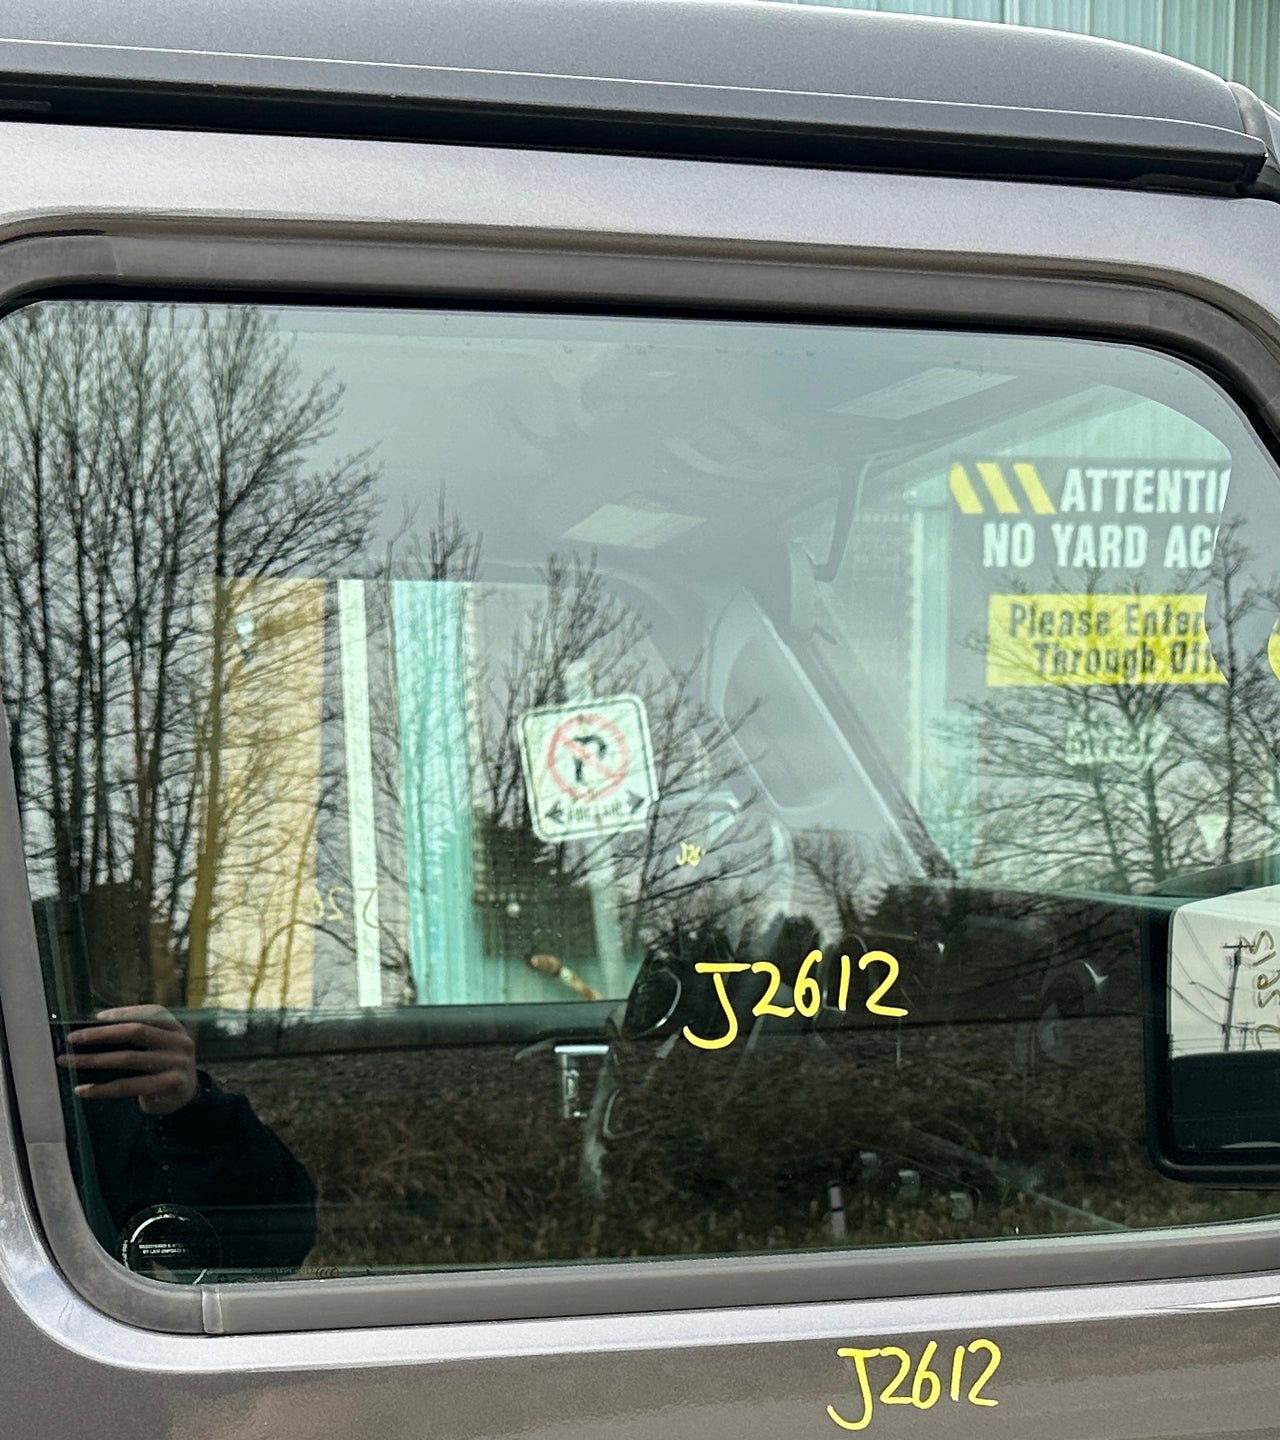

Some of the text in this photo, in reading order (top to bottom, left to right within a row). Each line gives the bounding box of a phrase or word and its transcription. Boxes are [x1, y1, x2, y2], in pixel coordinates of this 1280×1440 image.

[982, 521, 1036, 568] NO
[1051, 521, 1148, 569] YARD
[1008, 603, 1111, 638] Please
[1032, 641, 1156, 681] Through
[682, 949, 909, 1050] J2612
[826, 1338, 1002, 1431] J2612
